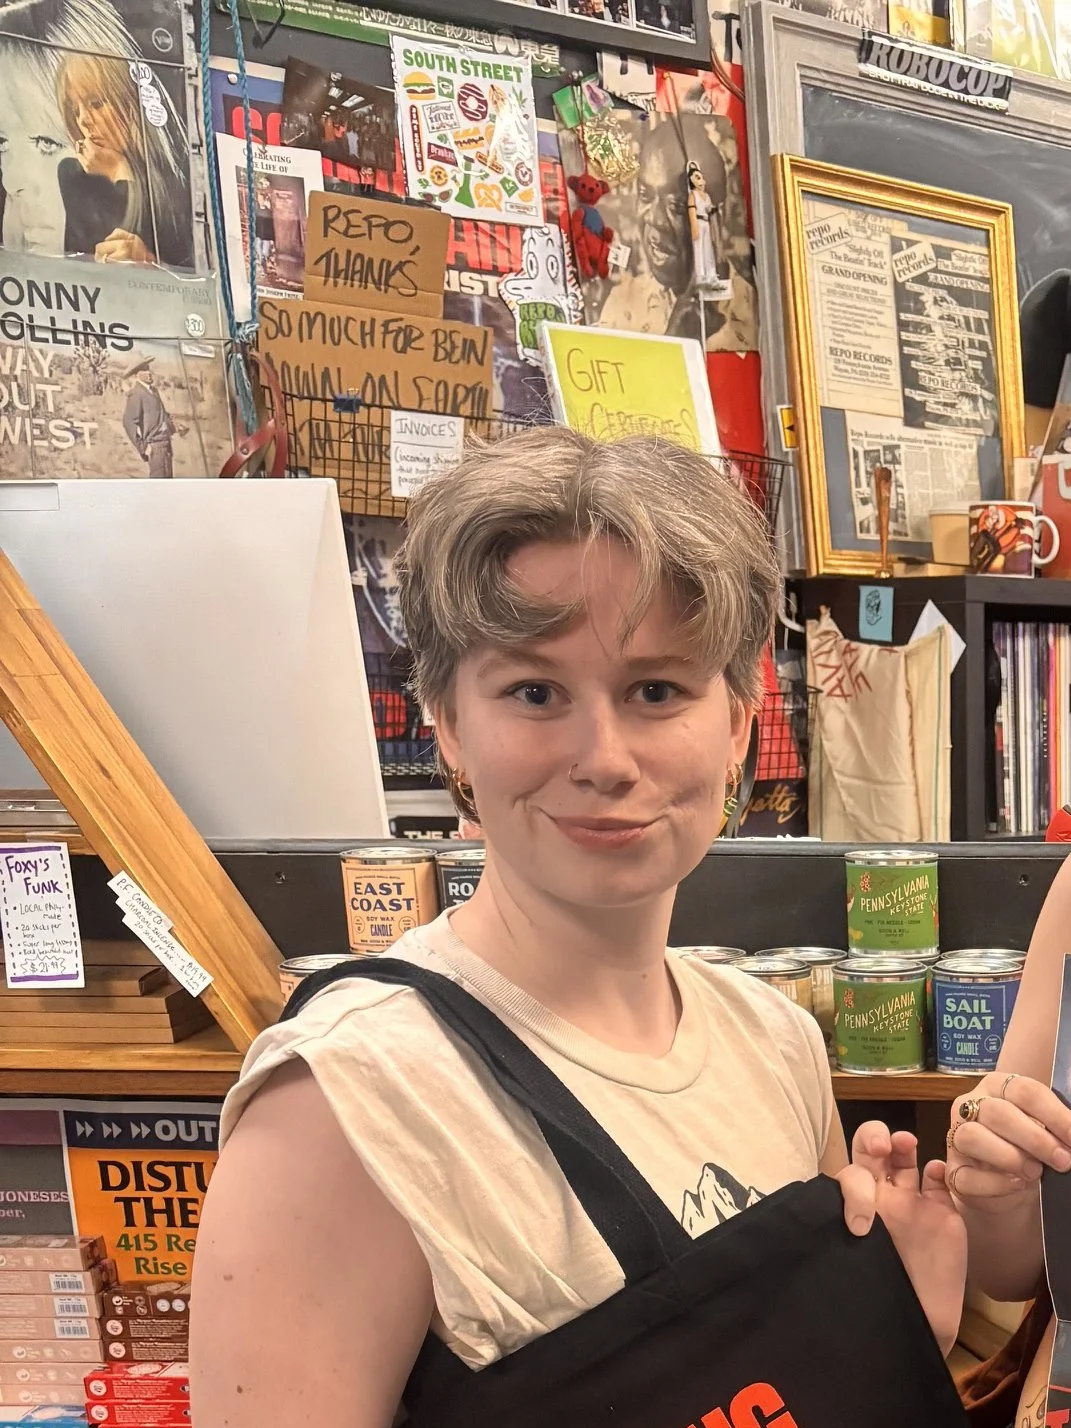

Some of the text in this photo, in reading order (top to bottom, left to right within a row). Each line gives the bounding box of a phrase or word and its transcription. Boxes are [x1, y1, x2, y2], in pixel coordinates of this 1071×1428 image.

[403, 48, 523, 83] SOUTH STREET
[868, 41, 1006, 98] ROBOCOP
[243, 147, 291, 164] CEBRATING
[806, 223, 831, 240] repo
[809, 229, 850, 251] records
[894, 251, 917, 268] repo
[897, 254, 935, 278] records
[313, 247, 418, 297] THANKS
[821, 264, 888, 286] GRAND OPENING
[259, 300, 293, 341] SO
[299, 310, 375, 350] MUCH
[382, 317, 425, 355] FOR
[432, 328, 488, 367] BEIN
[829, 346, 892, 366] REPO RECORDS
[566, 348, 625, 395] GIFT
[354, 882, 405, 896] EAST
[448, 882, 474, 896] RO
[861, 874, 930, 912] PENNSYLVANIA
[131, 892, 155, 917] CANDLE
[351, 897, 415, 912] COAST
[889, 893, 928, 916] KEYSTONE
[904, 902, 925, 917] STATE
[370, 924, 393, 937] CANDLE
[844, 991, 916, 1030] PENNSYLVANIA
[945, 997, 992, 1014] SAIL
[873, 1008, 913, 1033] KEYSTONE
[888, 1020, 910, 1034] STATE
[943, 1014, 995, 1031] BOAT
[956, 1042, 980, 1056] CANDLE
[154, 1118, 217, 1143] OUT
[114, 1196, 200, 1229] THE
[116, 1233, 157, 1252] 415
[135, 1256, 188, 1276] Rise
